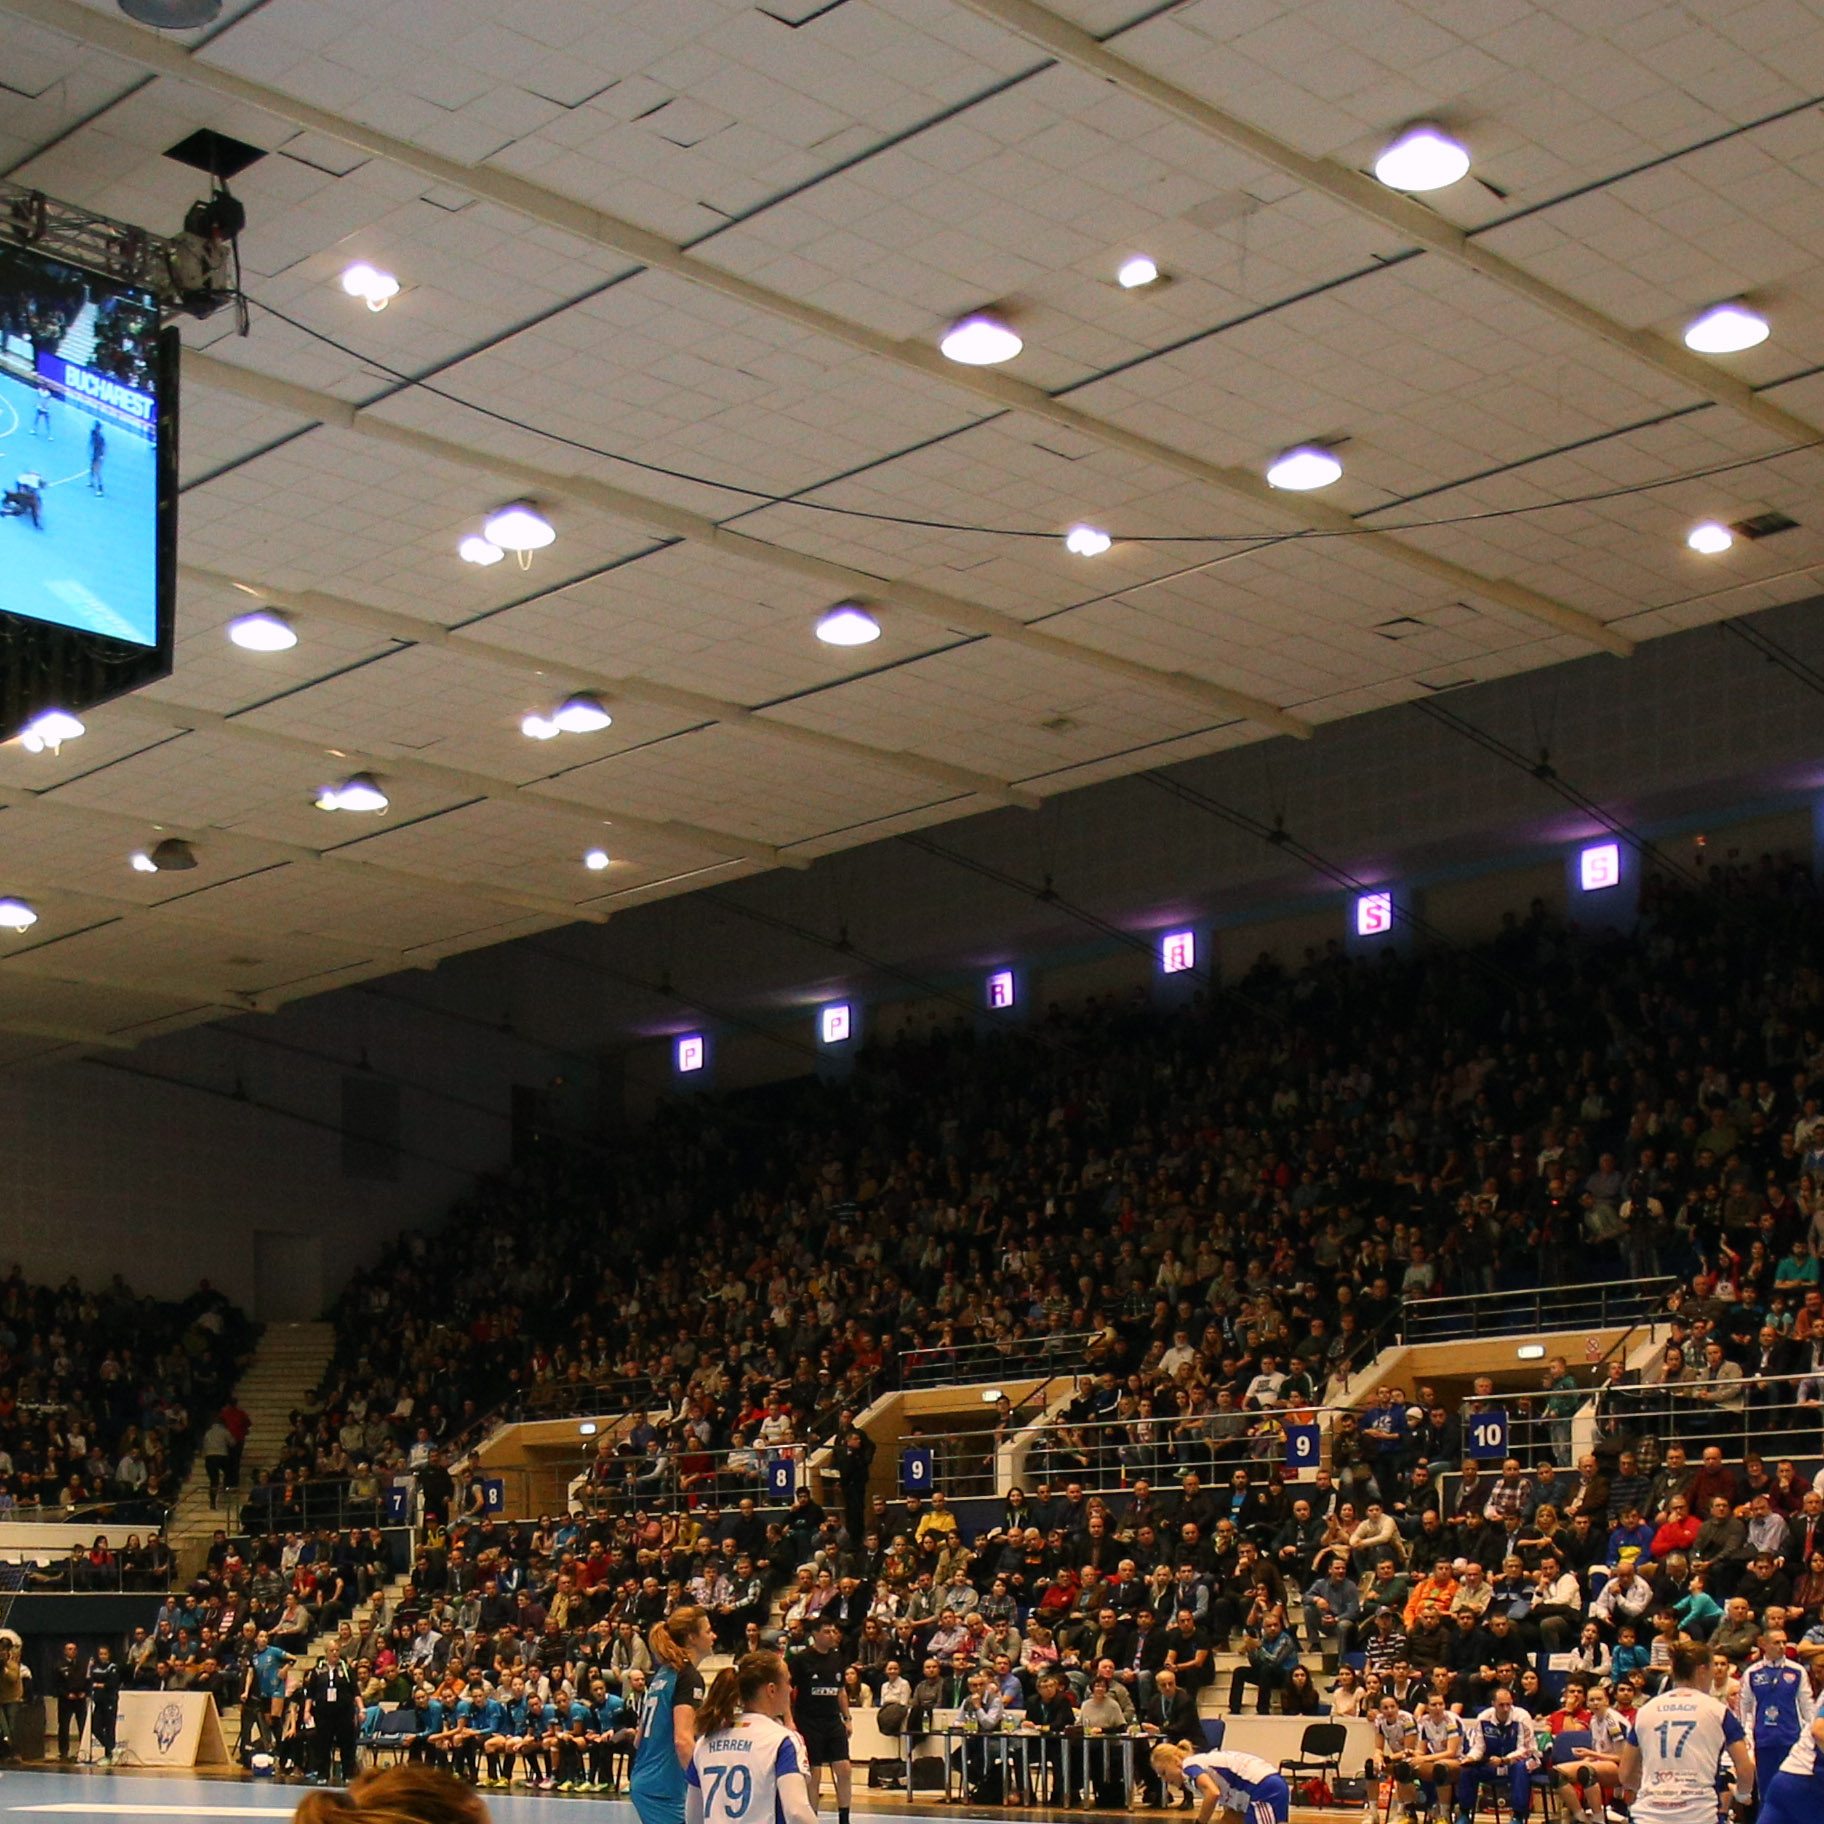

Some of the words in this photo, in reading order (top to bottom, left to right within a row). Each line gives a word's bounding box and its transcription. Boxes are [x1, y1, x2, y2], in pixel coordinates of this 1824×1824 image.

[65, 364, 154, 419] BUCHAREST
[1591, 856, 1608, 883] S
[1366, 904, 1382, 931] S
[1172, 944, 1185, 967] R
[991, 983, 1004, 1004] R
[831, 1017, 841, 1038] P
[685, 1047, 695, 1067] P
[1295, 1435, 1310, 1456] 9
[1474, 1423, 1502, 1447] 10
[776, 1469, 787, 1486] 8
[911, 1461, 923, 1479] 9
[392, 1495, 402, 1510] 7
[488, 1488, 498, 1504] 8
[709, 1739, 753, 1753] HERREM
[1654, 1720, 1697, 1758] 17
[703, 1764, 751, 1818] 79
